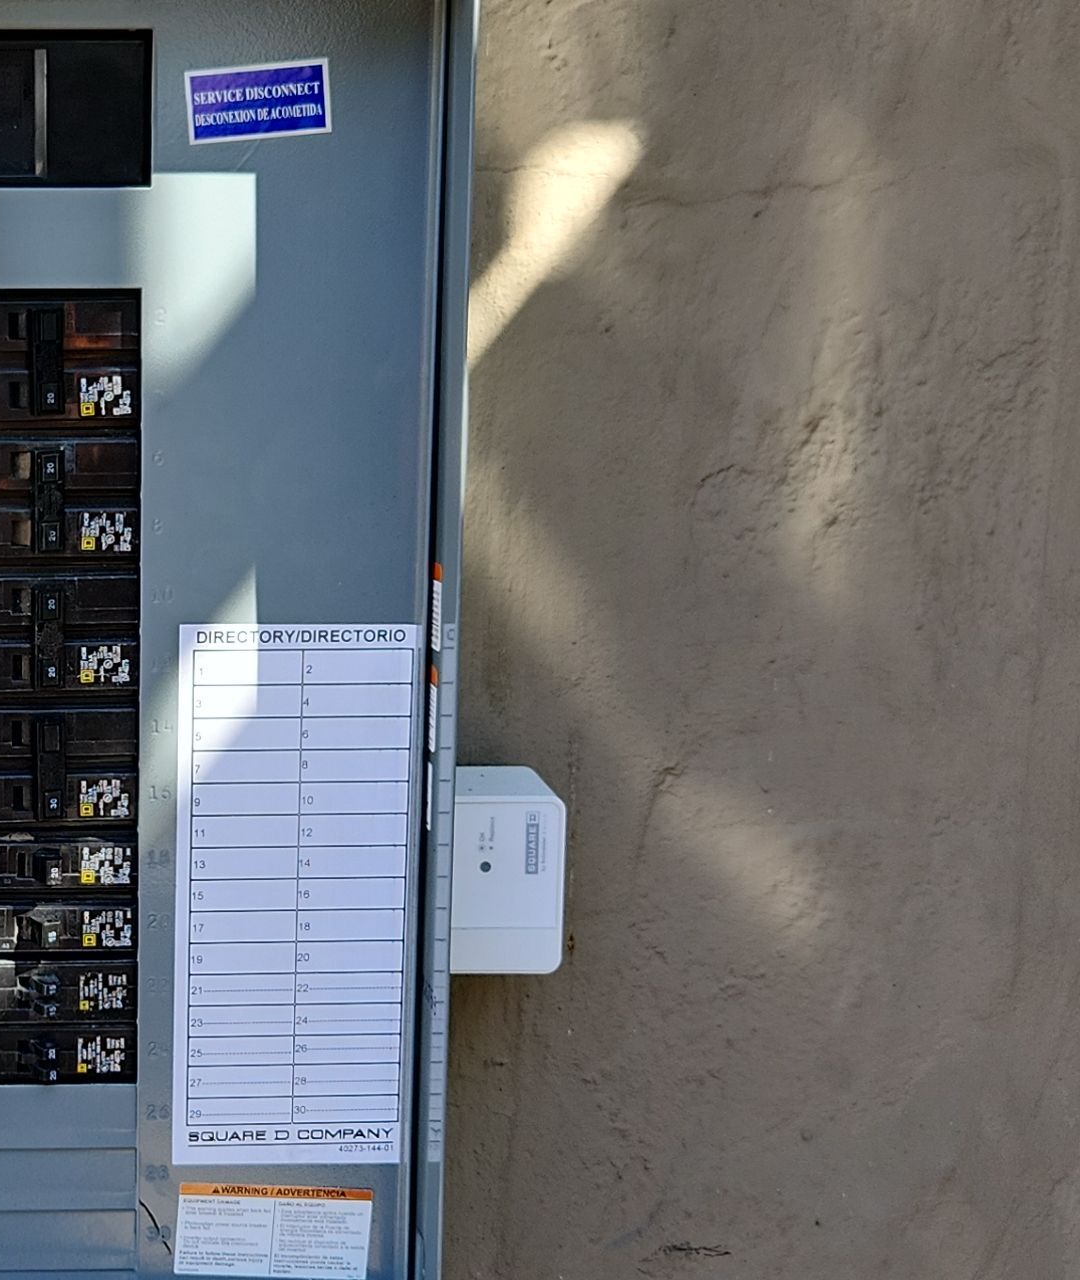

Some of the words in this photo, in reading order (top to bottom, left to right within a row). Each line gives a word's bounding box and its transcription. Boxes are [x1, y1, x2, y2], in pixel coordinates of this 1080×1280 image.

[193, 87, 244, 105] SERVICE
[246, 82, 320, 101] DISCONNECT
[195, 106, 256, 127] DESCONEXION
[257, 107, 270, 121] DE
[270, 103, 322, 120] ACOMETIDA
[197, 629, 406, 644] DIRECTORY/DIRECTORIO
[306, 665, 312, 674] 2
[195, 700, 202, 708] 3
[303, 697, 310, 706] 4
[195, 733, 201, 741] 5
[302, 730, 309, 739] 6
[195, 765, 201, 774] 7
[302, 761, 308, 769] 8
[194, 798, 200, 807] 9
[302, 796, 313, 805] 10
[194, 829, 205, 837] 11
[301, 828, 312, 837] 12
[527, 825, 536, 873] SQUARE
[194, 860, 206, 869] 13
[299, 859, 311, 868] 14
[192, 892, 204, 900] 15
[298, 890, 310, 899] 16
[193, 924, 204, 932] 17
[299, 922, 310, 931] 18
[191, 956, 203, 964] 19
[297, 953, 310, 962] 20
[191, 987, 202, 995] 21
[297, 984, 309, 993] 22
[191, 1019, 203, 1027] 23
[295, 1016, 308, 1025] 24
[295, 1044, 307, 1053] 26
[191, 1049, 203, 1058] 25
[190, 1079, 202, 1087] 27
[295, 1077, 306, 1085] 28
[189, 1110, 201, 1118] 29
[294, 1106, 306, 1114] 30
[188, 1130, 267, 1142] SQUARE
[274, 1129, 290, 1140] D
[297, 1128, 394, 1140] COMPANY
[220, 1187, 268, 1196] WARNING
[276, 1188, 346, 1198] ADVERTENCIA
